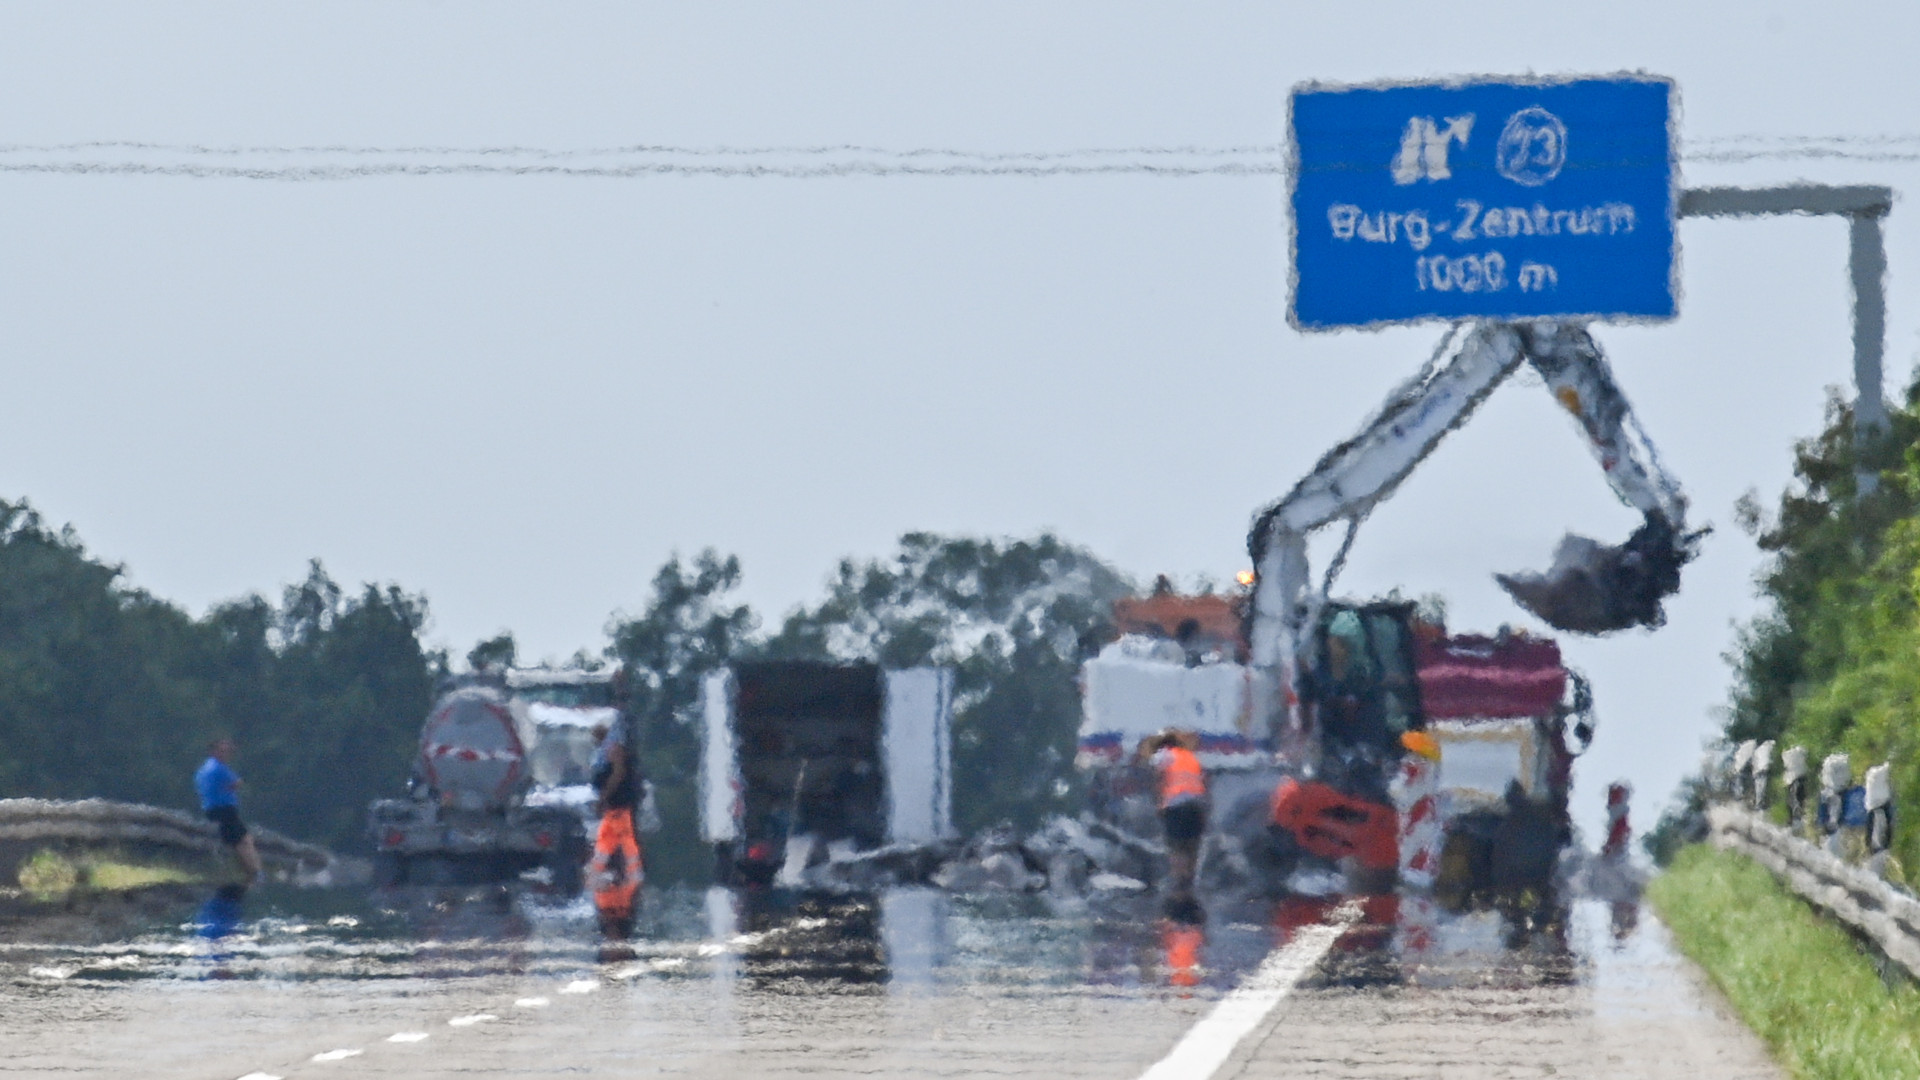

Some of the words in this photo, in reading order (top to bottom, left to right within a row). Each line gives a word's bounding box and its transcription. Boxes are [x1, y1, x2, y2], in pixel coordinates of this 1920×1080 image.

[1328, 200, 1635, 250] Burg-Zentrum
[1416, 250, 1506, 293] 1000
[1518, 261, 1558, 292] m
